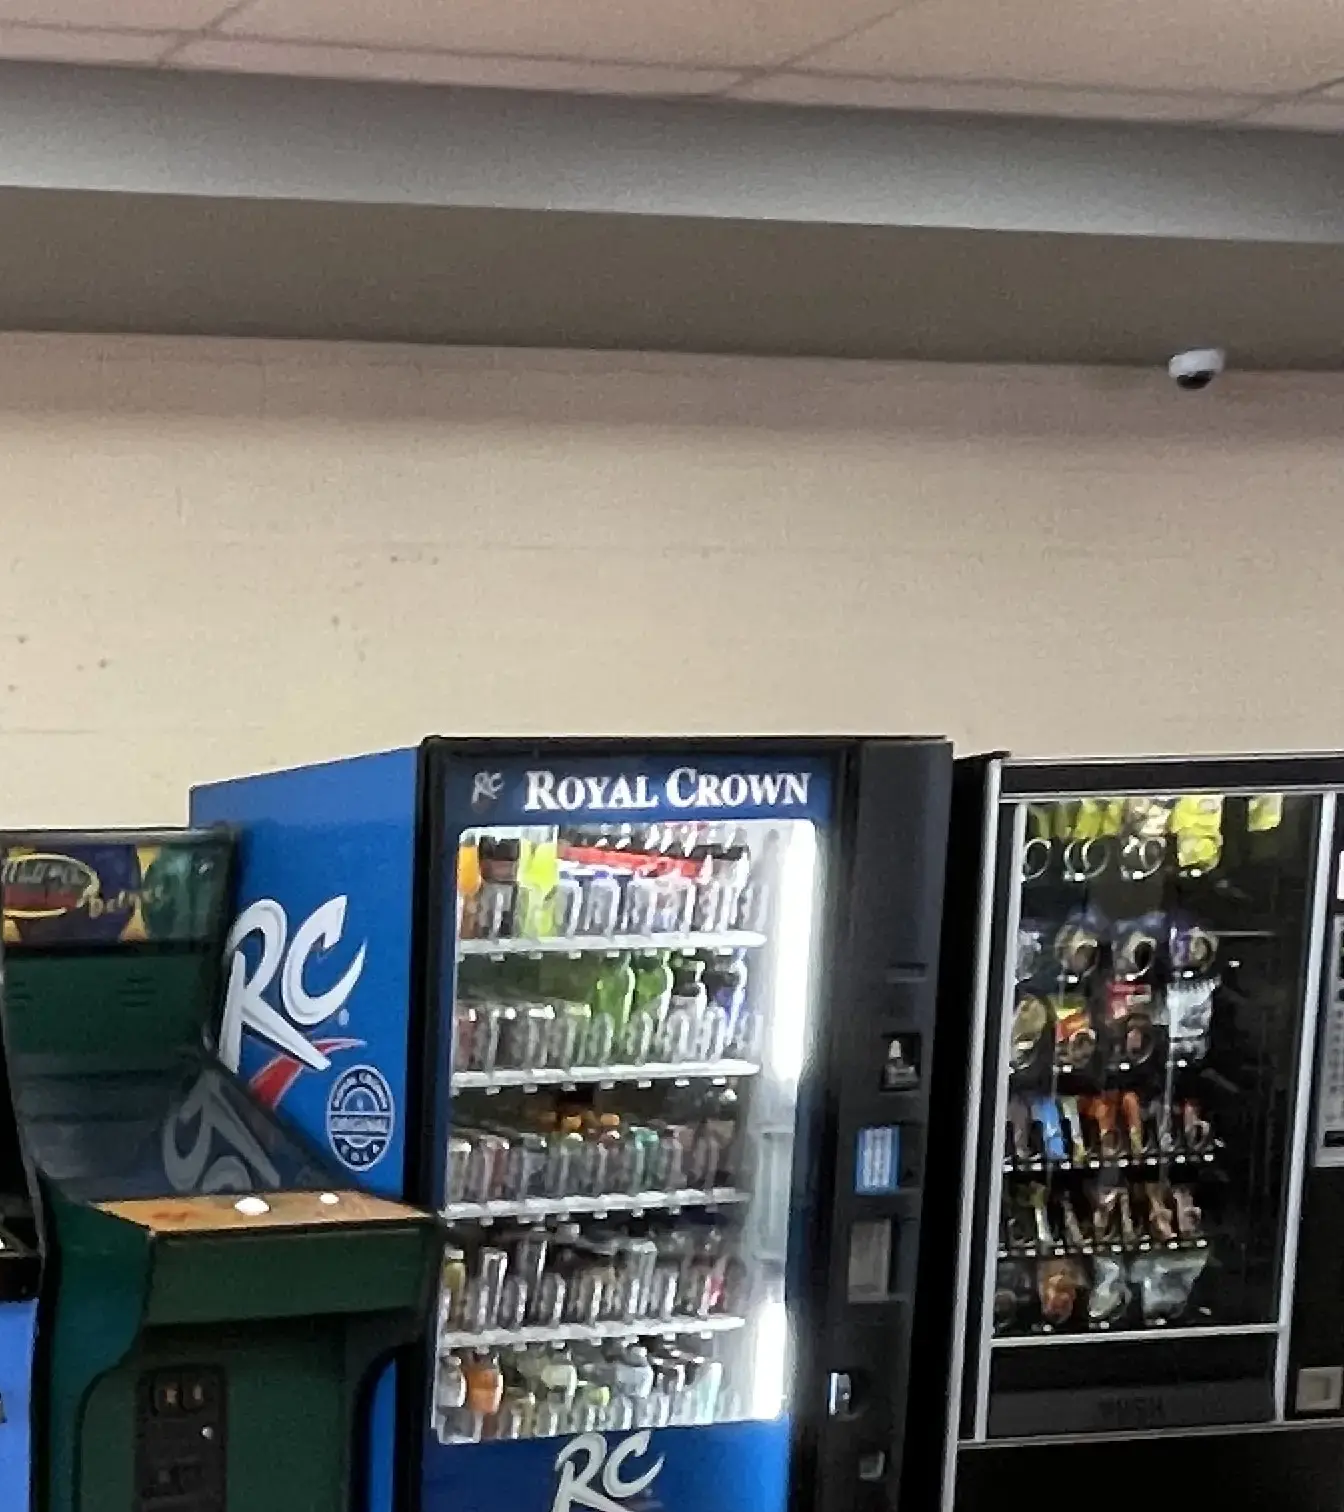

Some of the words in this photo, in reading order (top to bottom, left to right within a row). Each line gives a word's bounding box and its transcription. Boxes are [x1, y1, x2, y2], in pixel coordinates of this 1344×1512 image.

[472, 770, 504, 806] RC
[523, 769, 659, 812] ROYAL
[665, 766, 813, 809] CROWN
[218, 894, 368, 1075] RC
